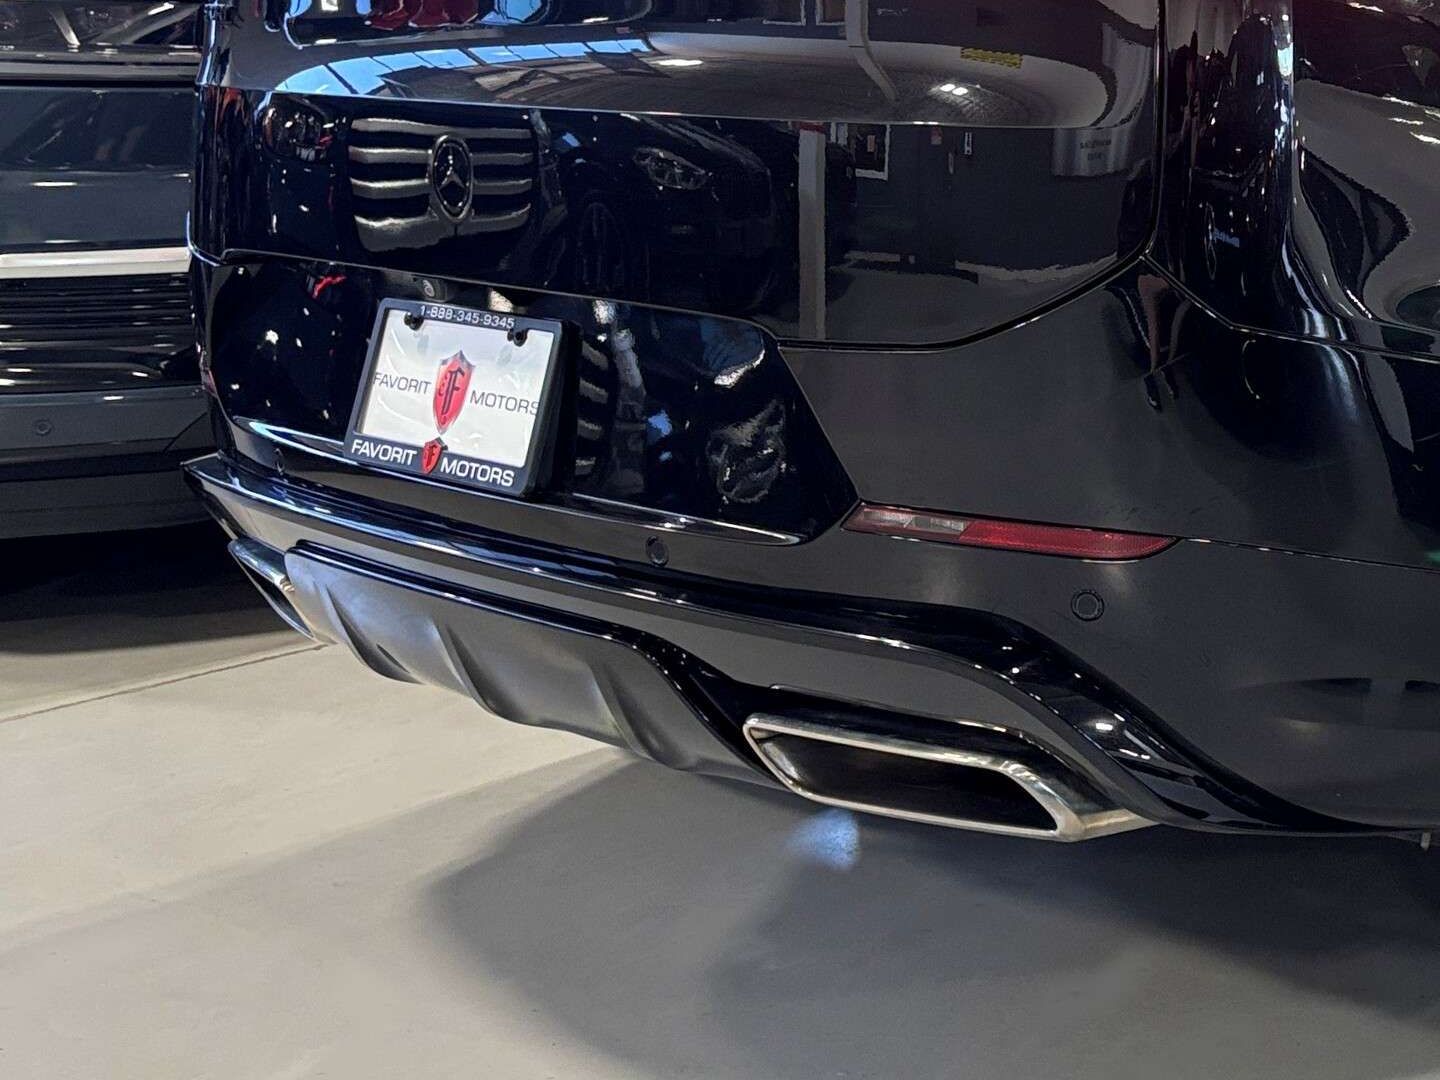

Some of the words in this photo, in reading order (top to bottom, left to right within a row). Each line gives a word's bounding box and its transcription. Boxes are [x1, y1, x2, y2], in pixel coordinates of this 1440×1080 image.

[420, 305, 515, 329] 1-888-345-9345
[373, 371, 432, 395] FAVORIT
[469, 389, 540, 417] MOTORS
[351, 439, 417, 466] FAVORIT
[440, 459, 515, 487] MOTORS
